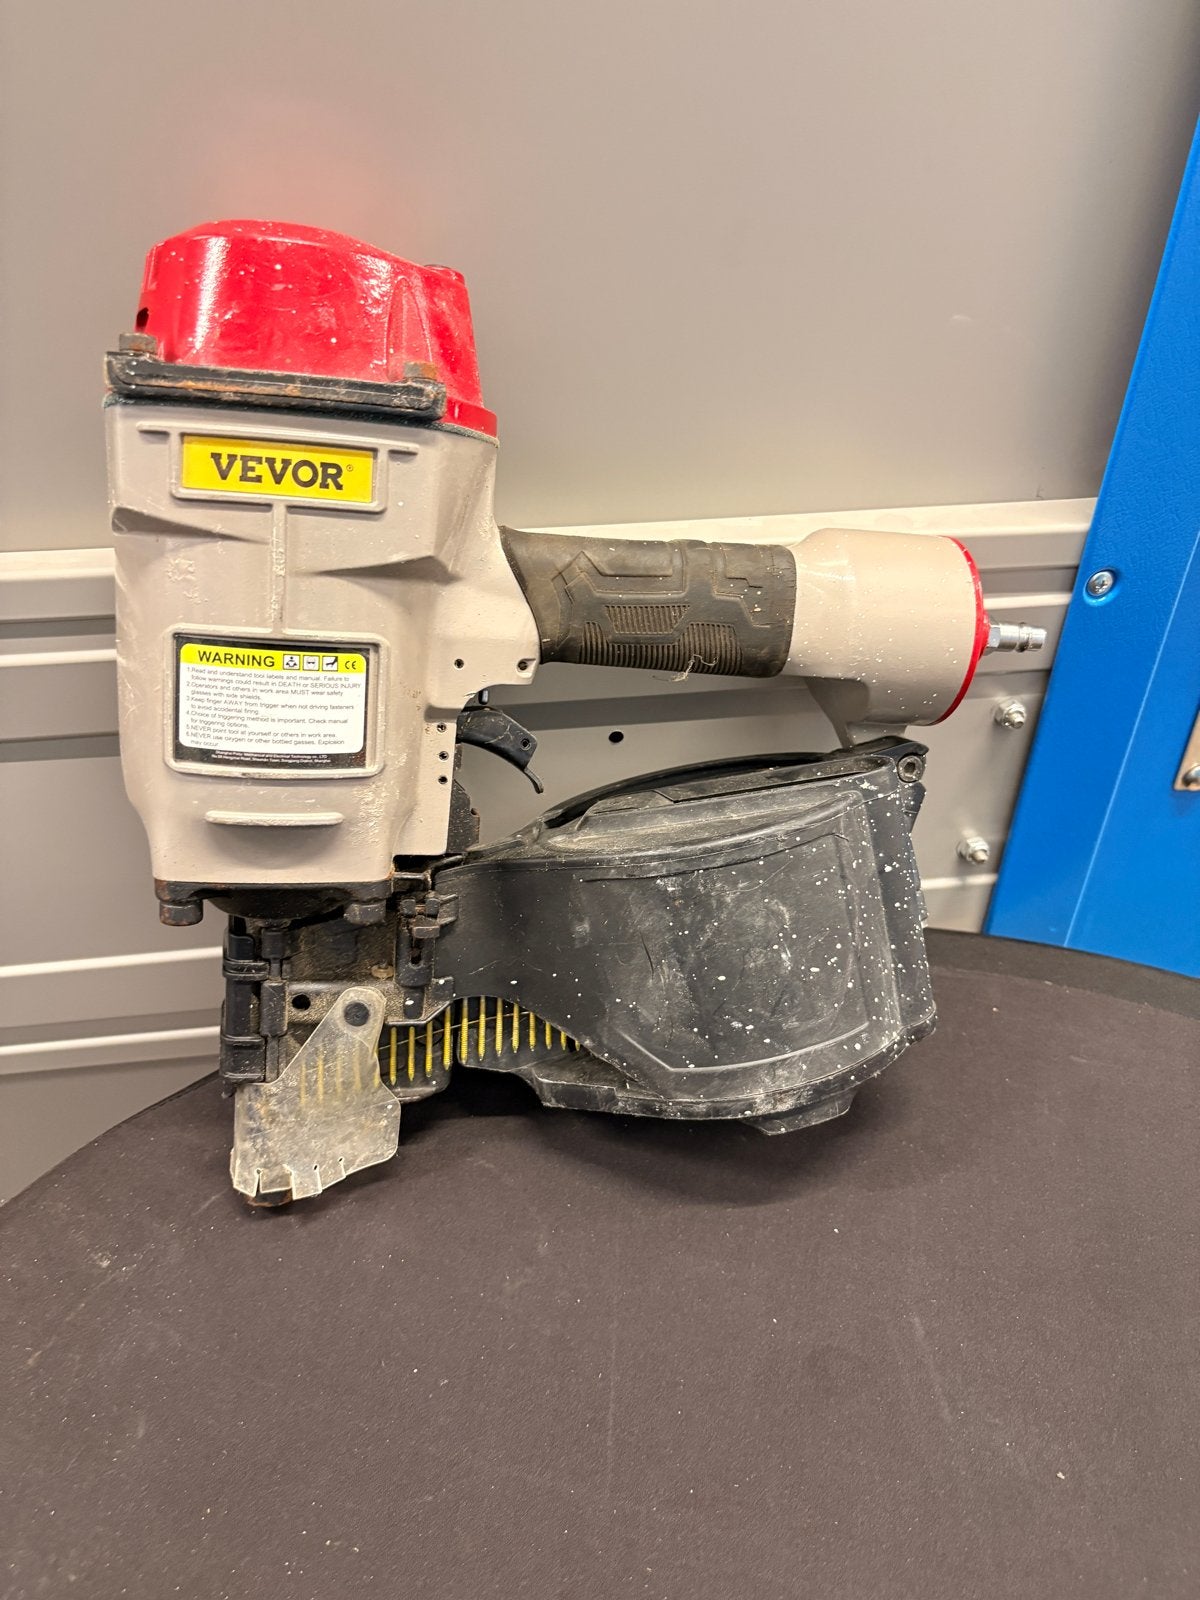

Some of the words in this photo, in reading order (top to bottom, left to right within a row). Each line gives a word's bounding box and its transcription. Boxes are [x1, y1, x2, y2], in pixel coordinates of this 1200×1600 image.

[210, 452, 344, 491] VEVOR
[197, 649, 275, 667] WARNING
[208, 677, 234, 685] warnings
[190, 689, 212, 697] glasses
[206, 697, 223, 705] finger
[259, 702, 279, 710] trigger
[217, 713, 245, 722] triggering
[199, 719, 225, 727] triggering
[247, 730, 272, 738] yourself
